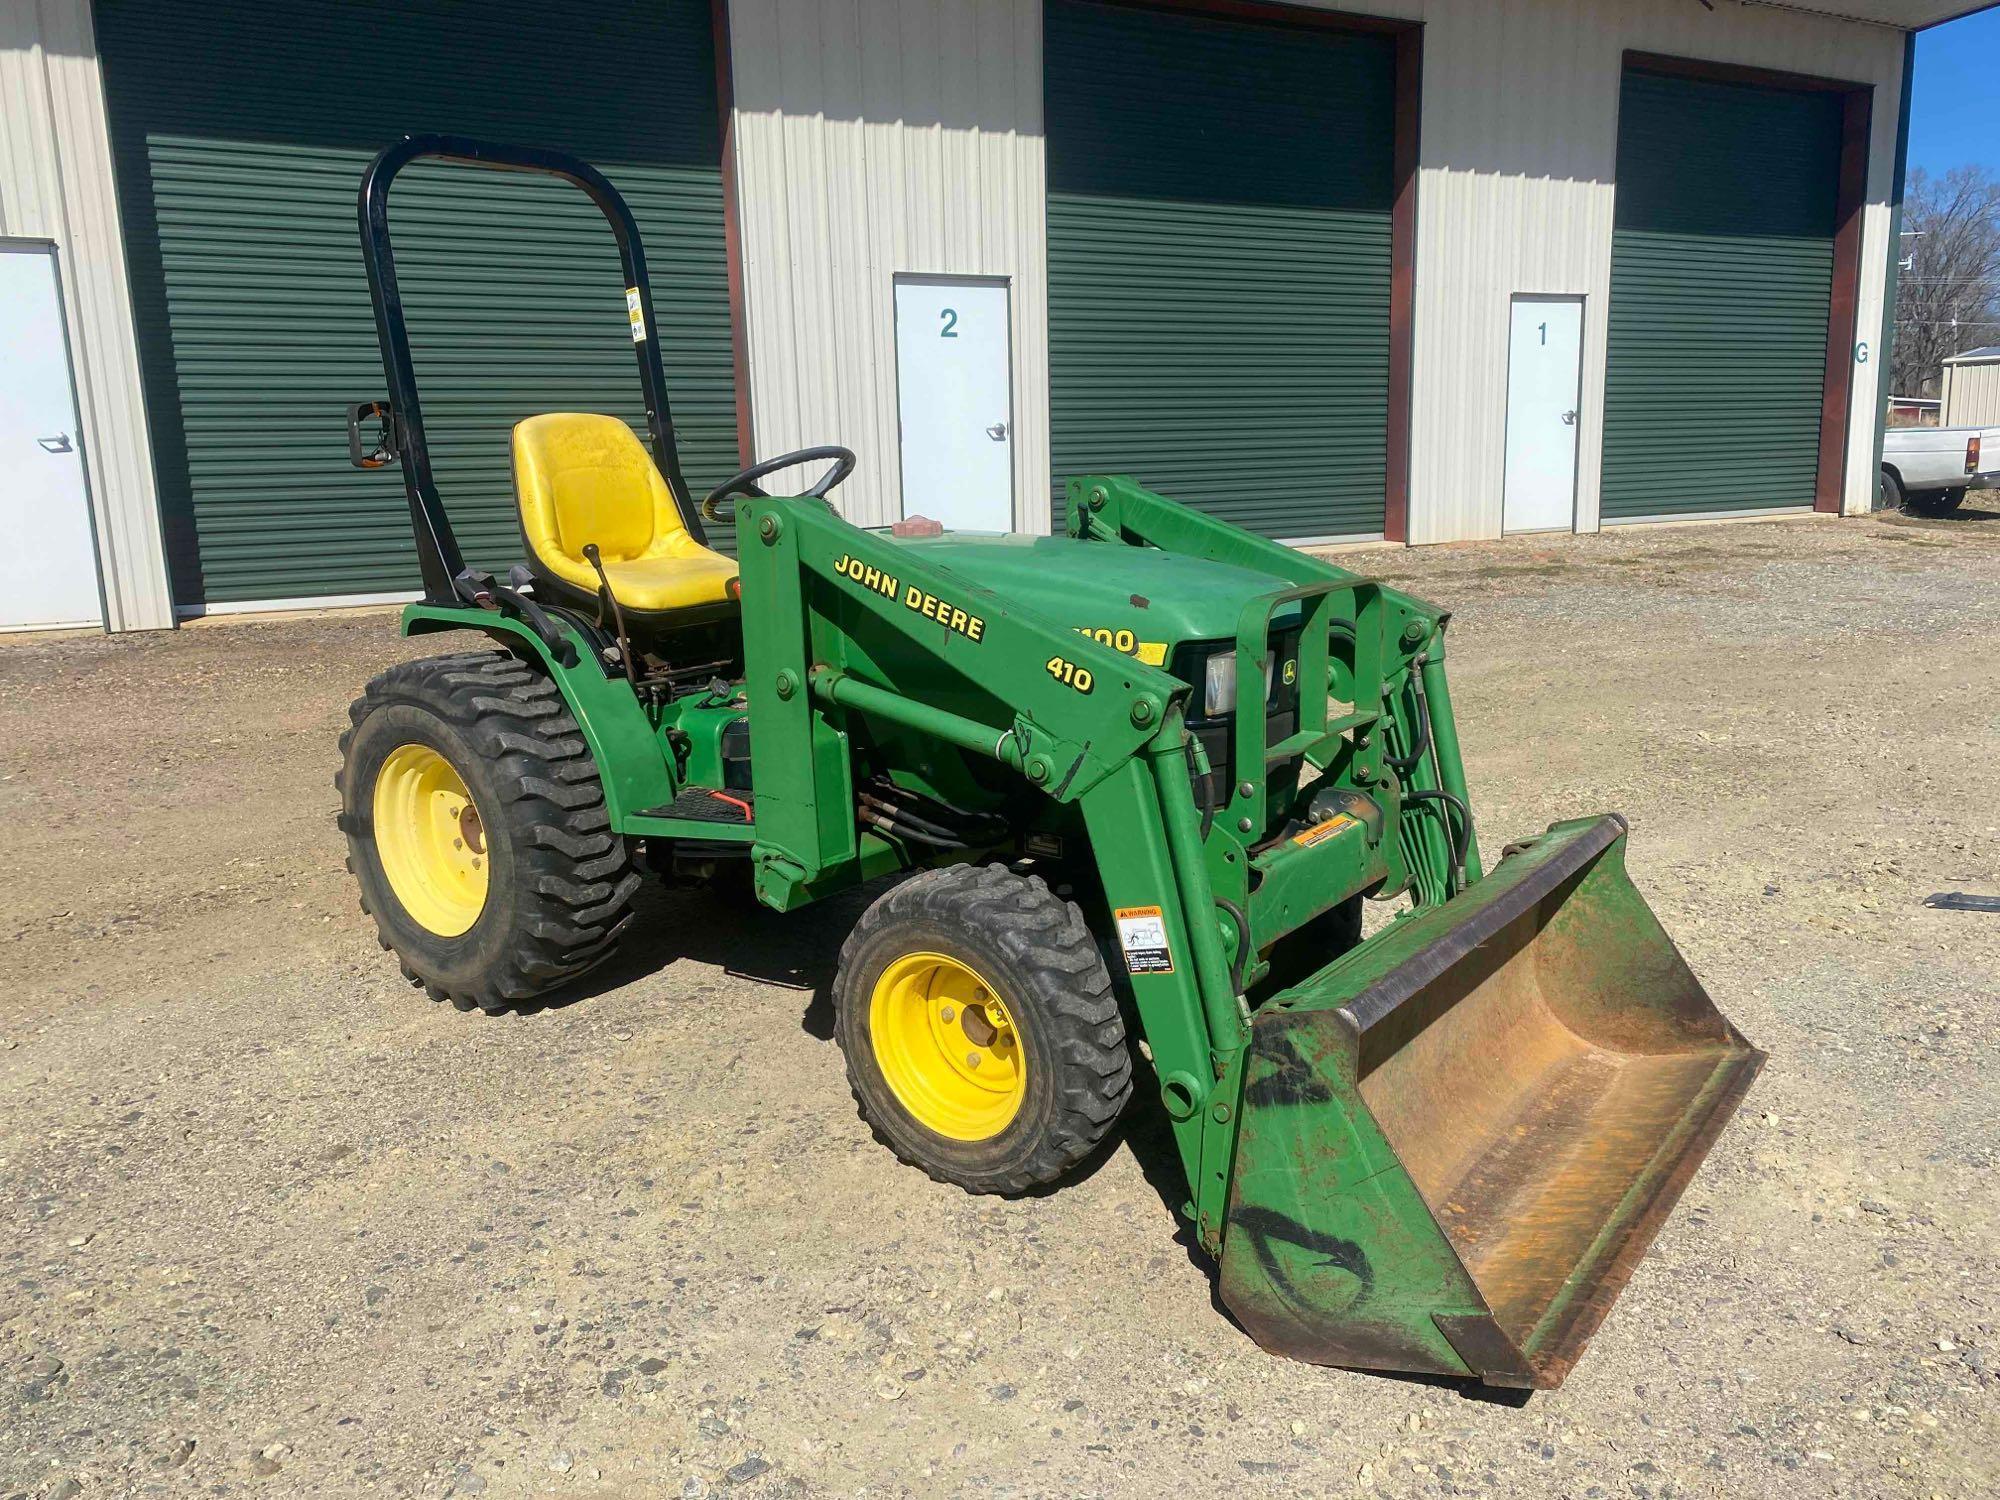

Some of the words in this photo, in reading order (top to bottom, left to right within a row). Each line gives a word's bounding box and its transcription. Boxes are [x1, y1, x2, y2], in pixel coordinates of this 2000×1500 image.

[940, 308, 958, 338] 2
[1538, 321, 1547, 346] 1
[1854, 341, 1868, 363] G
[834, 553, 899, 602] JOHN
[905, 584, 987, 645] DEERE
[1046, 655, 1095, 696] 410
[1127, 908, 1157, 917] WARNING
